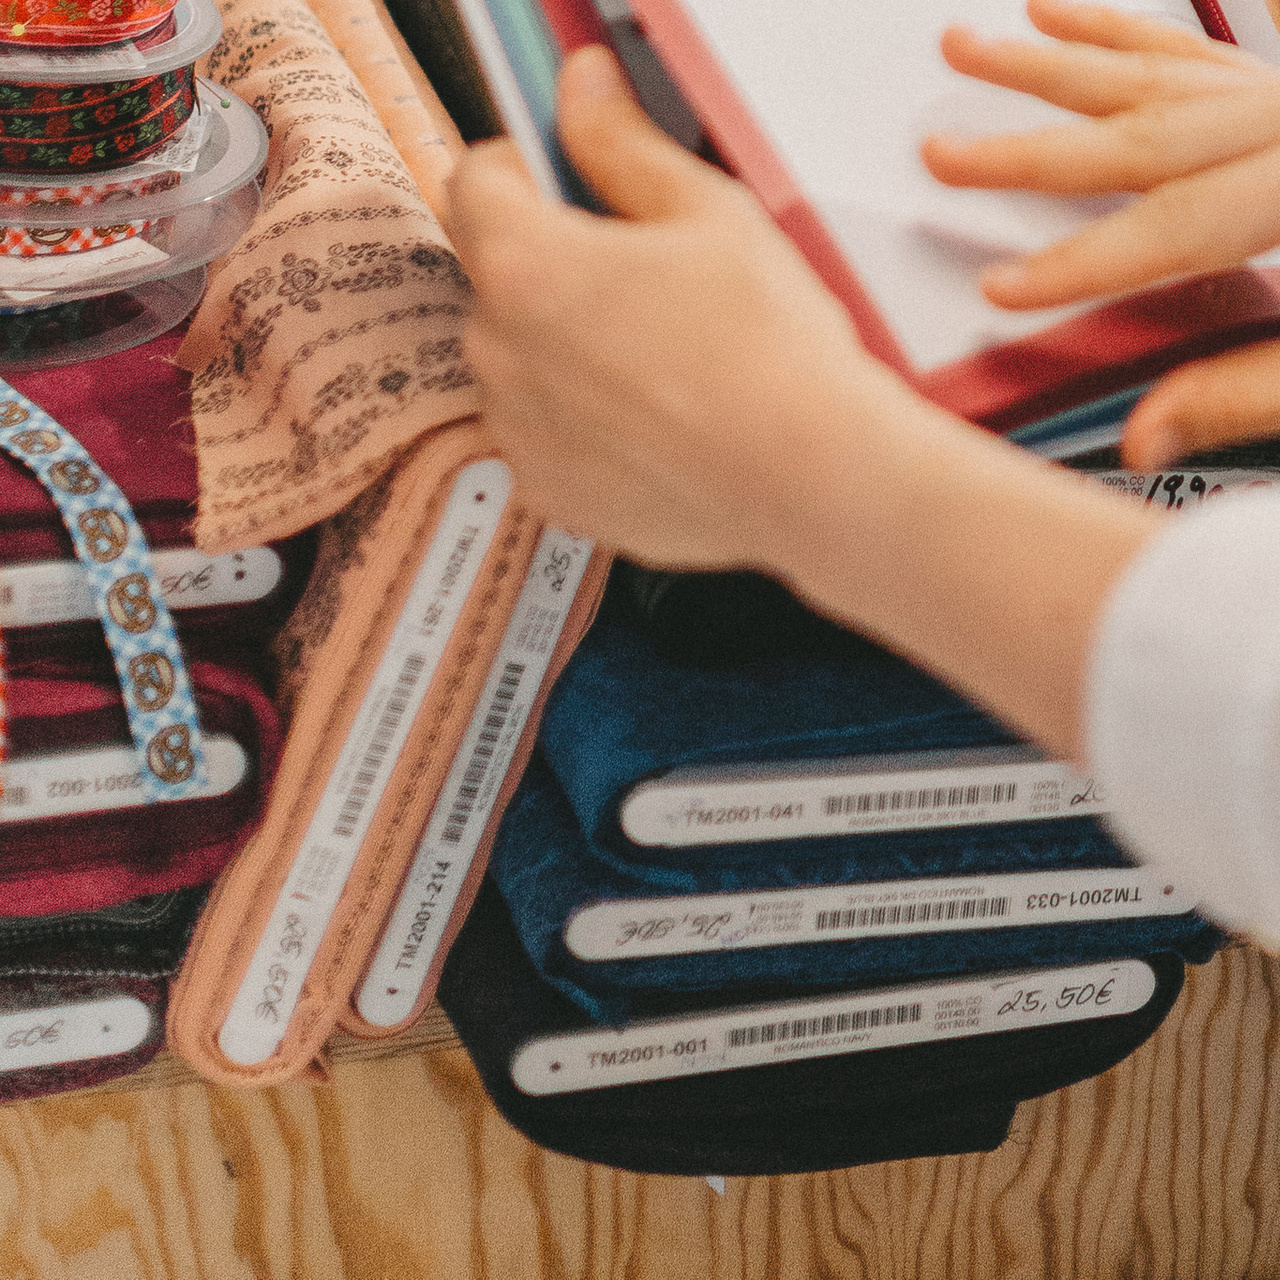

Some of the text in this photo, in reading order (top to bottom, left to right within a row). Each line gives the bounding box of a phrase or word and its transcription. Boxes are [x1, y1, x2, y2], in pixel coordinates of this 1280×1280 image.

[1129, 475, 1145, 486] CO
[1144, 473, 1223, 510] 19,9
[684, 802, 804, 826] TM2001-041
[1026, 887, 1143, 910] TM2001-033
[394, 860, 452, 971] TM2001-214
[996, 978, 1117, 1017] 25,50€
[587, 1038, 708, 1069] TM2001-001
